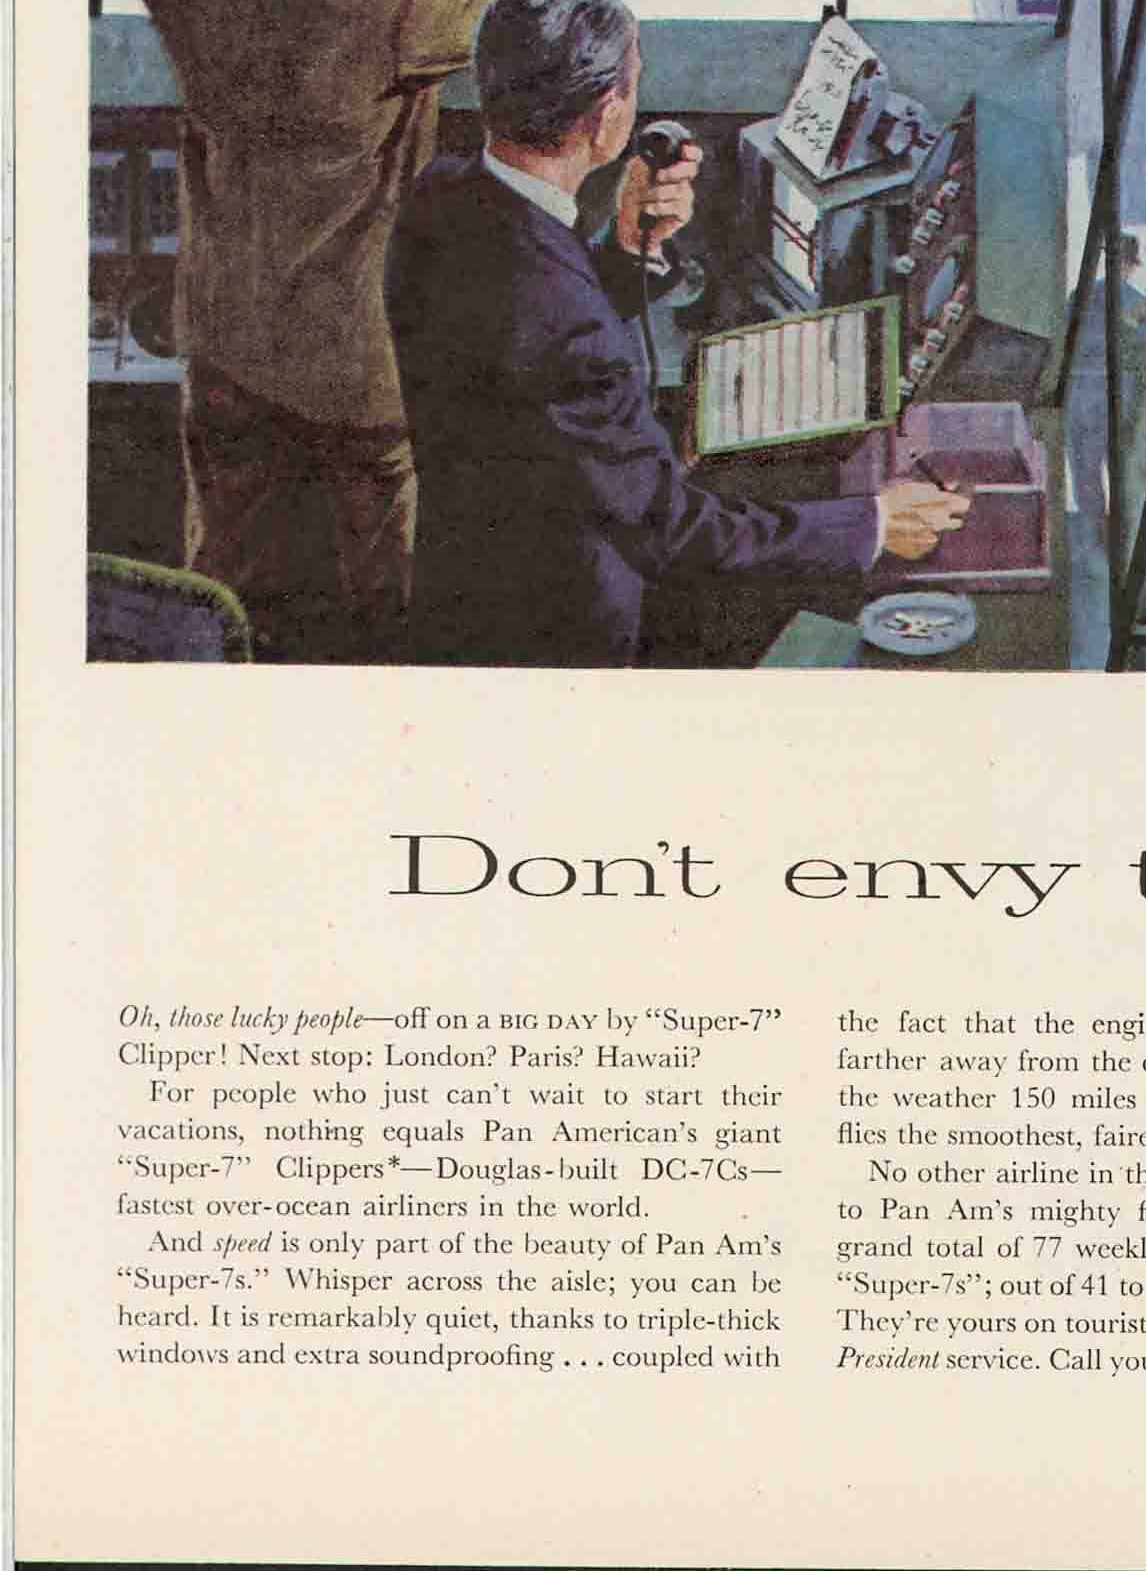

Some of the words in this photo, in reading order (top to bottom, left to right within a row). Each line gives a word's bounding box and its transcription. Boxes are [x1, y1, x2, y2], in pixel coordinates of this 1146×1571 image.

[388, 834, 721, 899] Don't
[784, 859, 1081, 918] envy
[119, 1004, 160, 1029] Oh,
[169, 1005, 224, 1028] those
[231, 1005, 289, 1036] lucky
[436, 1014, 468, 1030] on
[476, 1014, 491, 1030] a
[500, 1013, 539, 1030] BIG
[548, 1014, 598, 1030] DAY
[607, 1007, 638, 1037] by
[645, 1007, 782, 1038] "Super-7"
[838, 1009, 879, 1033] the
[899, 1009, 946, 1034] fact
[964, 1010, 1017, 1034] that
[1034, 1011, 1075, 1035] the
[118, 1041, 226, 1072] Clipper!
[239, 1043, 300, 1066] Next
[311, 1049, 372, 1073] stop:
[385, 1044, 497, 1067] London?
[510, 1044, 584, 1068] Paris?
[597, 1045, 701, 1069] Hawaii?
[151, 1079, 195, 1103] For
[213, 1080, 297, 1110] people
[312, 1081, 367, 1104] who
[379, 1081, 429, 1110] just
[446, 1082, 511, 1105] can't
[529, 1082, 585, 1105] wait
[604, 1088, 628, 1106] to
[645, 1088, 703, 1106] start
[722, 1084, 783, 1107] their
[839, 1084, 879, 1108] the
[893, 1085, 997, 1109] weather
[1013, 1086, 1056, 1109] 150
[1071, 1086, 1137, 1110] miles
[118, 1117, 245, 1142] vacations,
[265, 1118, 365, 1147] nothing
[383, 1119, 464, 1149] equals
[483, 1119, 532, 1142] Pan
[551, 1120, 697, 1143] American's
[715, 1121, 782, 1150] giant
[838, 1121, 887, 1145] flies
[898, 1122, 937, 1145] the
[947, 1123, 1082, 1151] smoothest,
[118, 1192, 193, 1216] fastest
[206, 1200, 351, 1216] over-ocean
[363, 1193, 468, 1217] airliners
[479, 1194, 504, 1217] in
[517, 1194, 557, 1218] the
[568, 1195, 649, 1218] world.
[837, 1202, 863, 1220] to
[881, 1197, 929, 1220] Pan
[947, 1198, 1013, 1221] Am's
[1031, 1198, 1121, 1229] mighty
[148, 1230, 202, 1253] And
[213, 1230, 273, 1260] speed
[281, 1230, 300, 1253] is
[309, 1230, 365, 1260] only
[375, 1237, 428, 1260] part
[439, 1231, 466, 1254] of
[474, 1231, 513, 1254] the
[524, 1231, 611, 1262] beauty
[621, 1232, 648, 1255] of
[655, 1232, 705, 1256] Pan
[715, 1233, 782, 1256] Am's
[836, 1234, 913, 1262] grand
[927, 1235, 984, 1258] total
[997, 1236, 1024, 1258] of
[1033, 1236, 1062, 1258] 77
[119, 1304, 198, 1327] heard.
[212, 1304, 231, 1327] It
[241, 1304, 259, 1327] is
[268, 1305, 417, 1335] remarkably
[426, 1305, 499, 1336] quiet,
[510, 1306, 594, 1329] thanks
[603, 1312, 628, 1330] to
[637, 1307, 781, 1337] triple-thick
[836, 1308, 939, 1339] They're
[947, 1317, 1017, 1339] yours
[1024, 1318, 1057, 1334] on
[836, 1345, 940, 1369] President
[946, 1347, 1040, 1370] service.
[1049, 1347, 1102, 1371] Call
